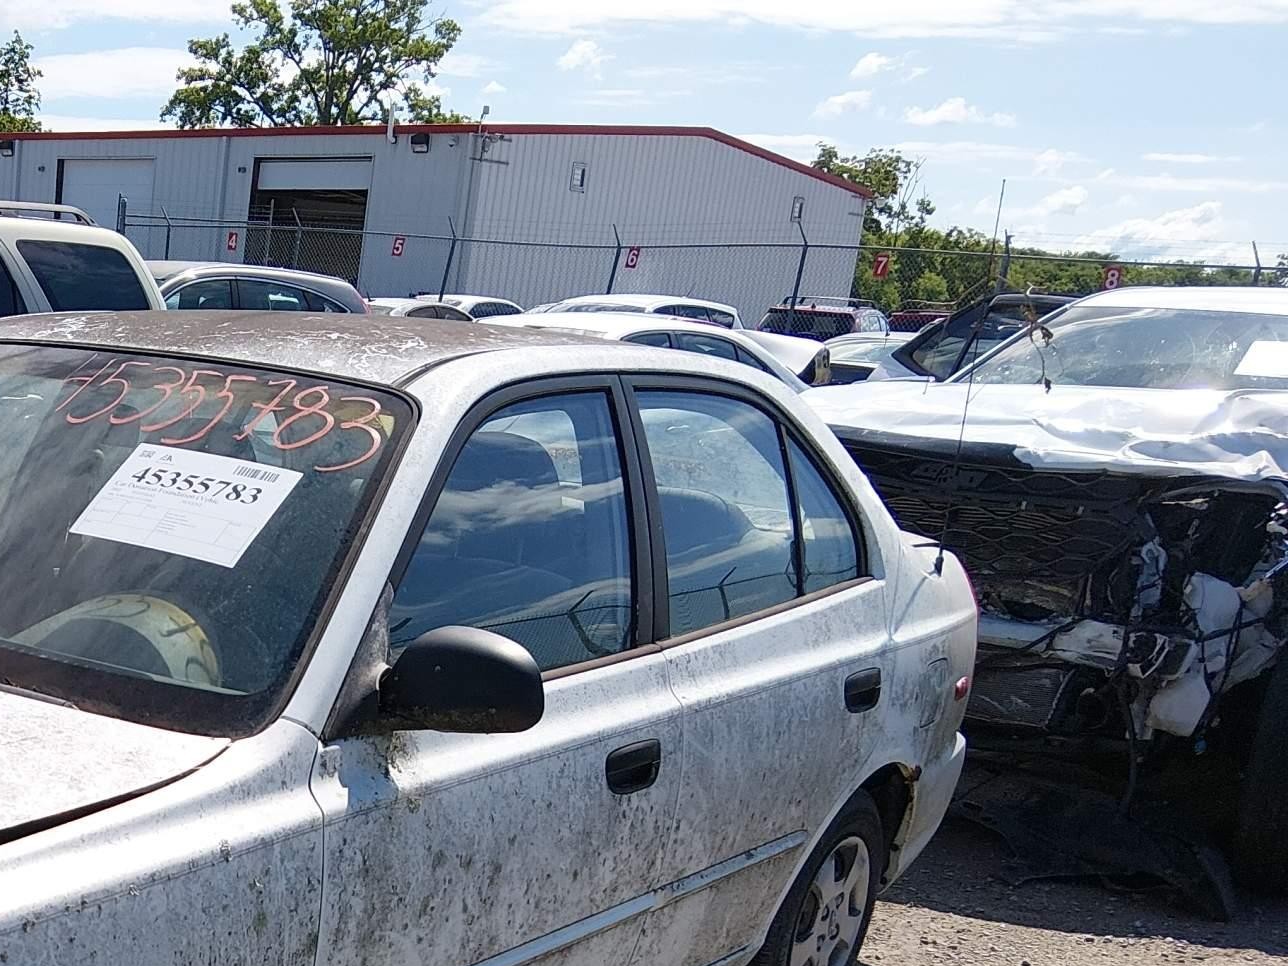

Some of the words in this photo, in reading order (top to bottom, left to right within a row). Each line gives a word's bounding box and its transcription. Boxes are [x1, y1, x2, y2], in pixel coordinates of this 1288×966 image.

[1104, 269, 1120, 289] 8
[56, 354, 382, 472] 45355783
[132, 466, 262, 505] 45355783
